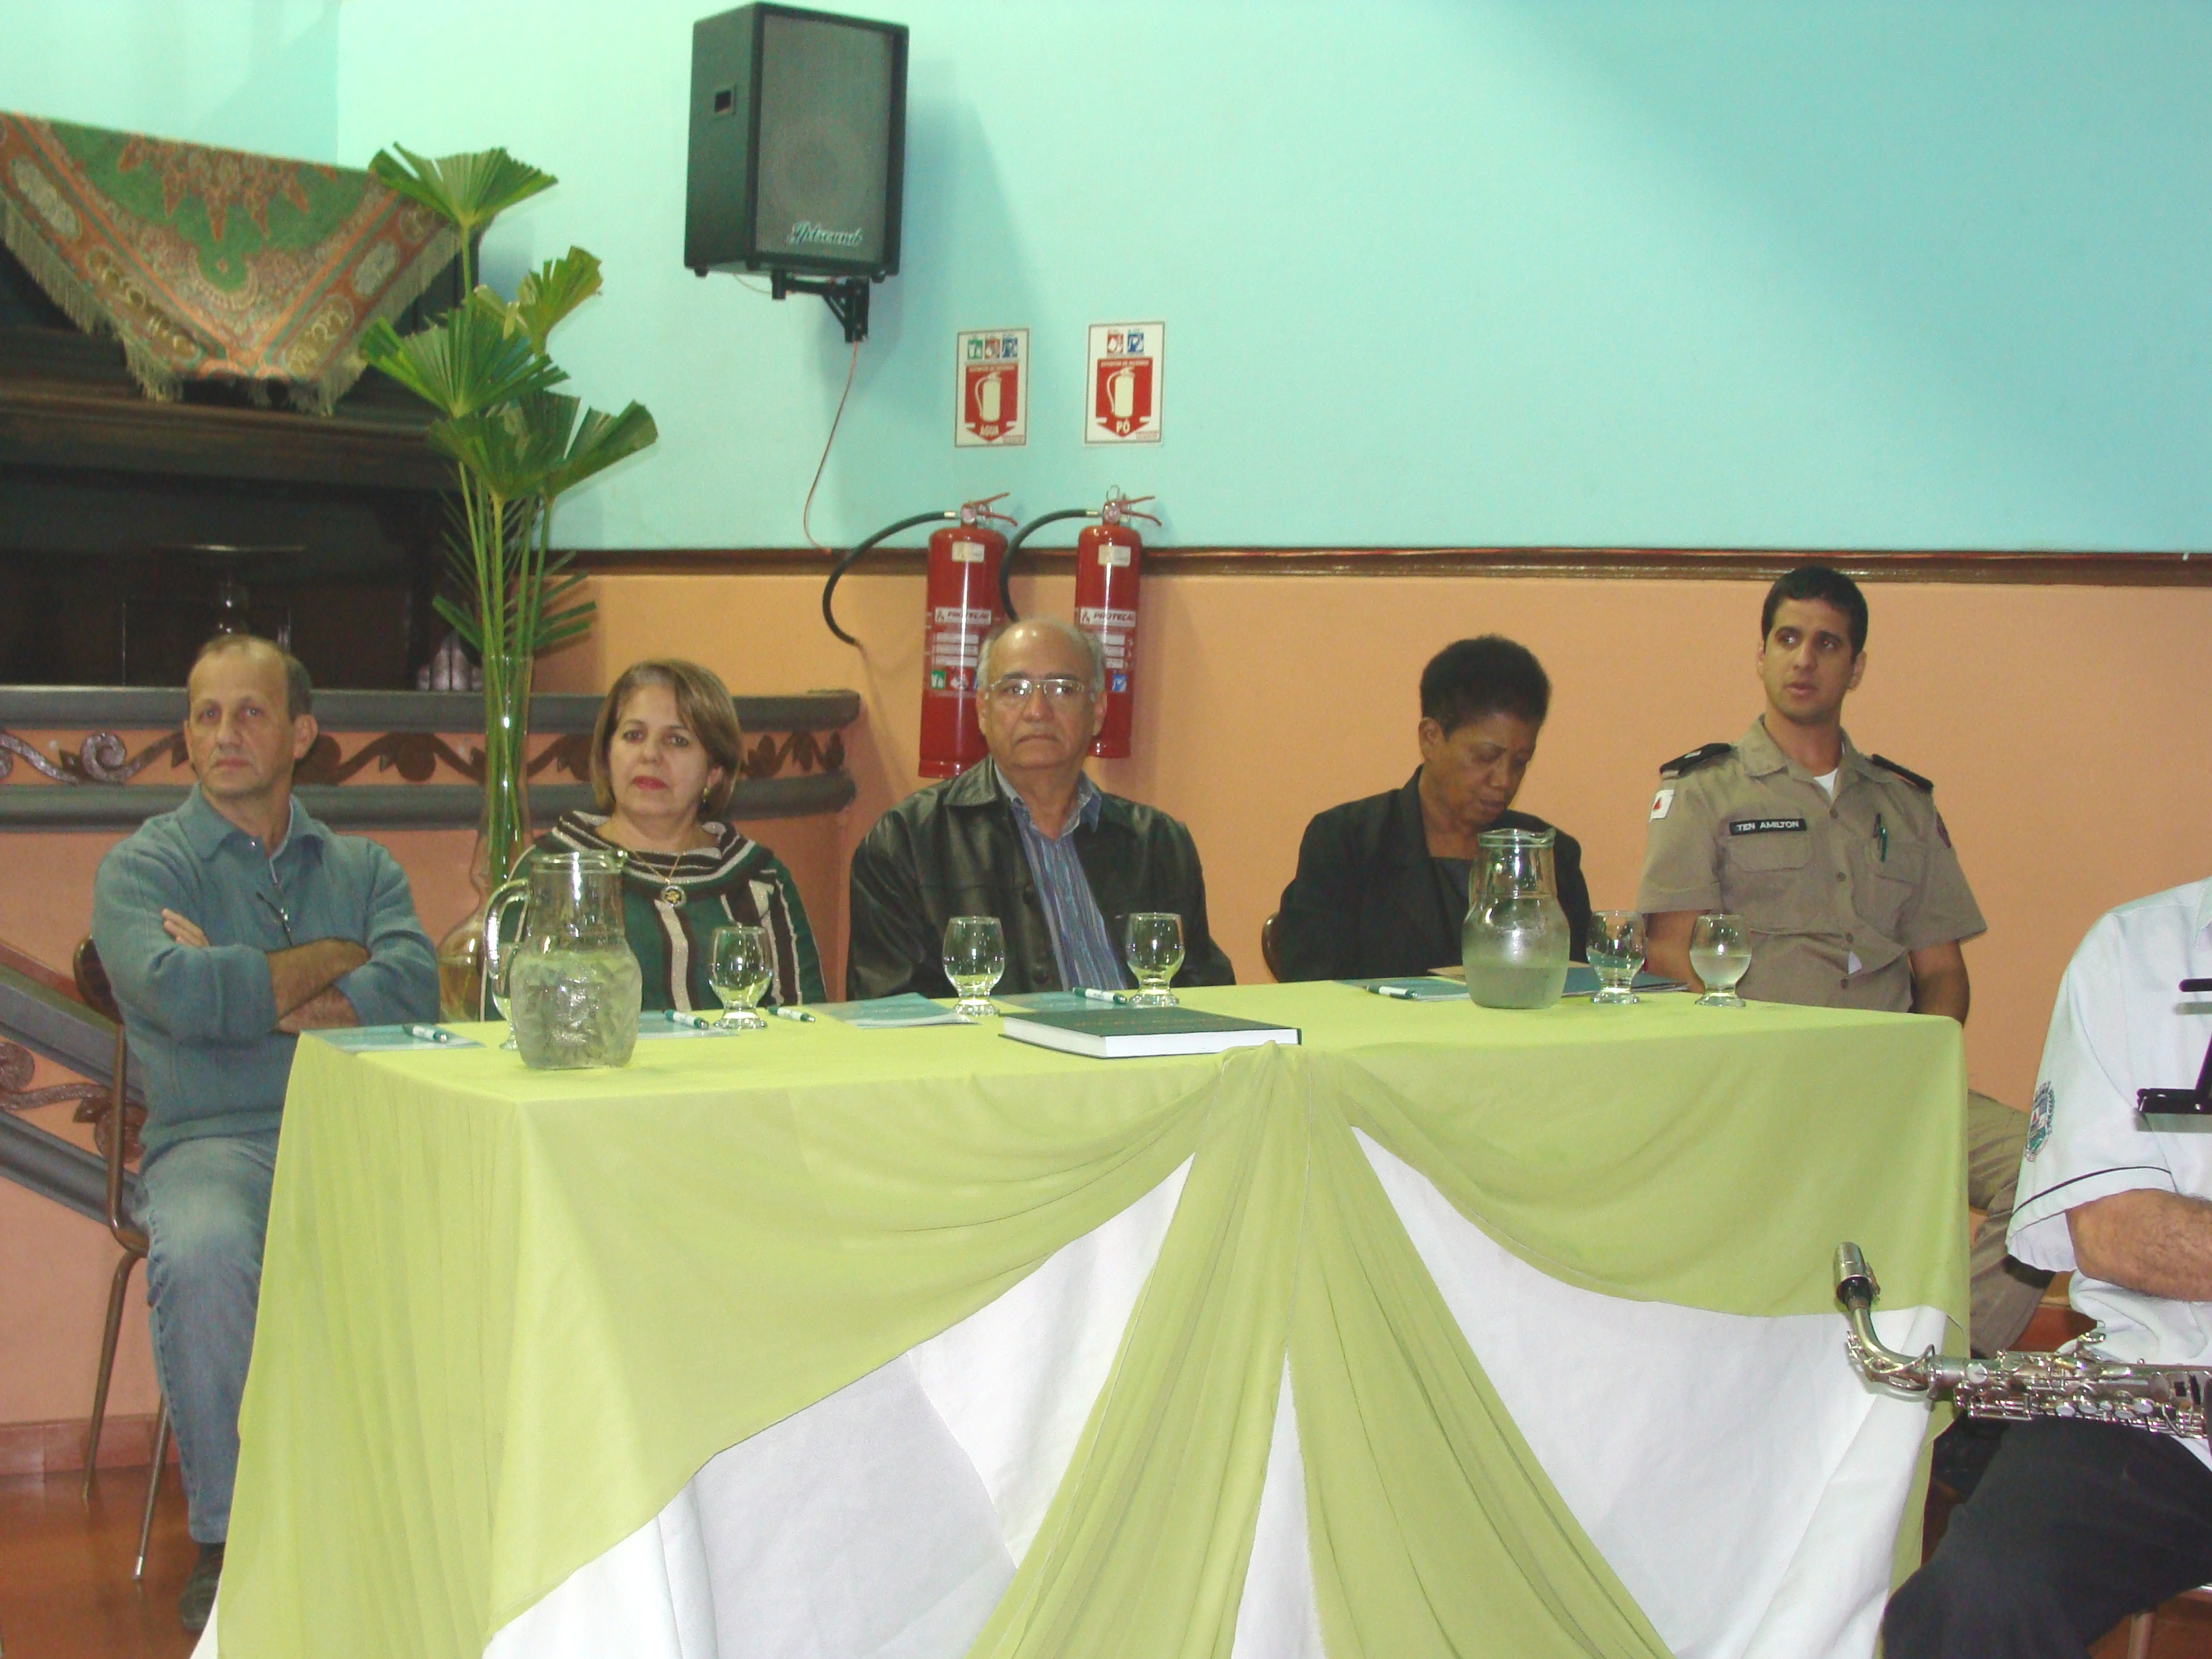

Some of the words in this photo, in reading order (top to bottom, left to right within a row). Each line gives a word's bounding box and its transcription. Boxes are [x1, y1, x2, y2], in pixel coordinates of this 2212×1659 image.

[1115, 418, 1131, 434] PÓ
[1736, 822, 1756, 832] TEN
[1759, 821, 1799, 830] AMILTON
